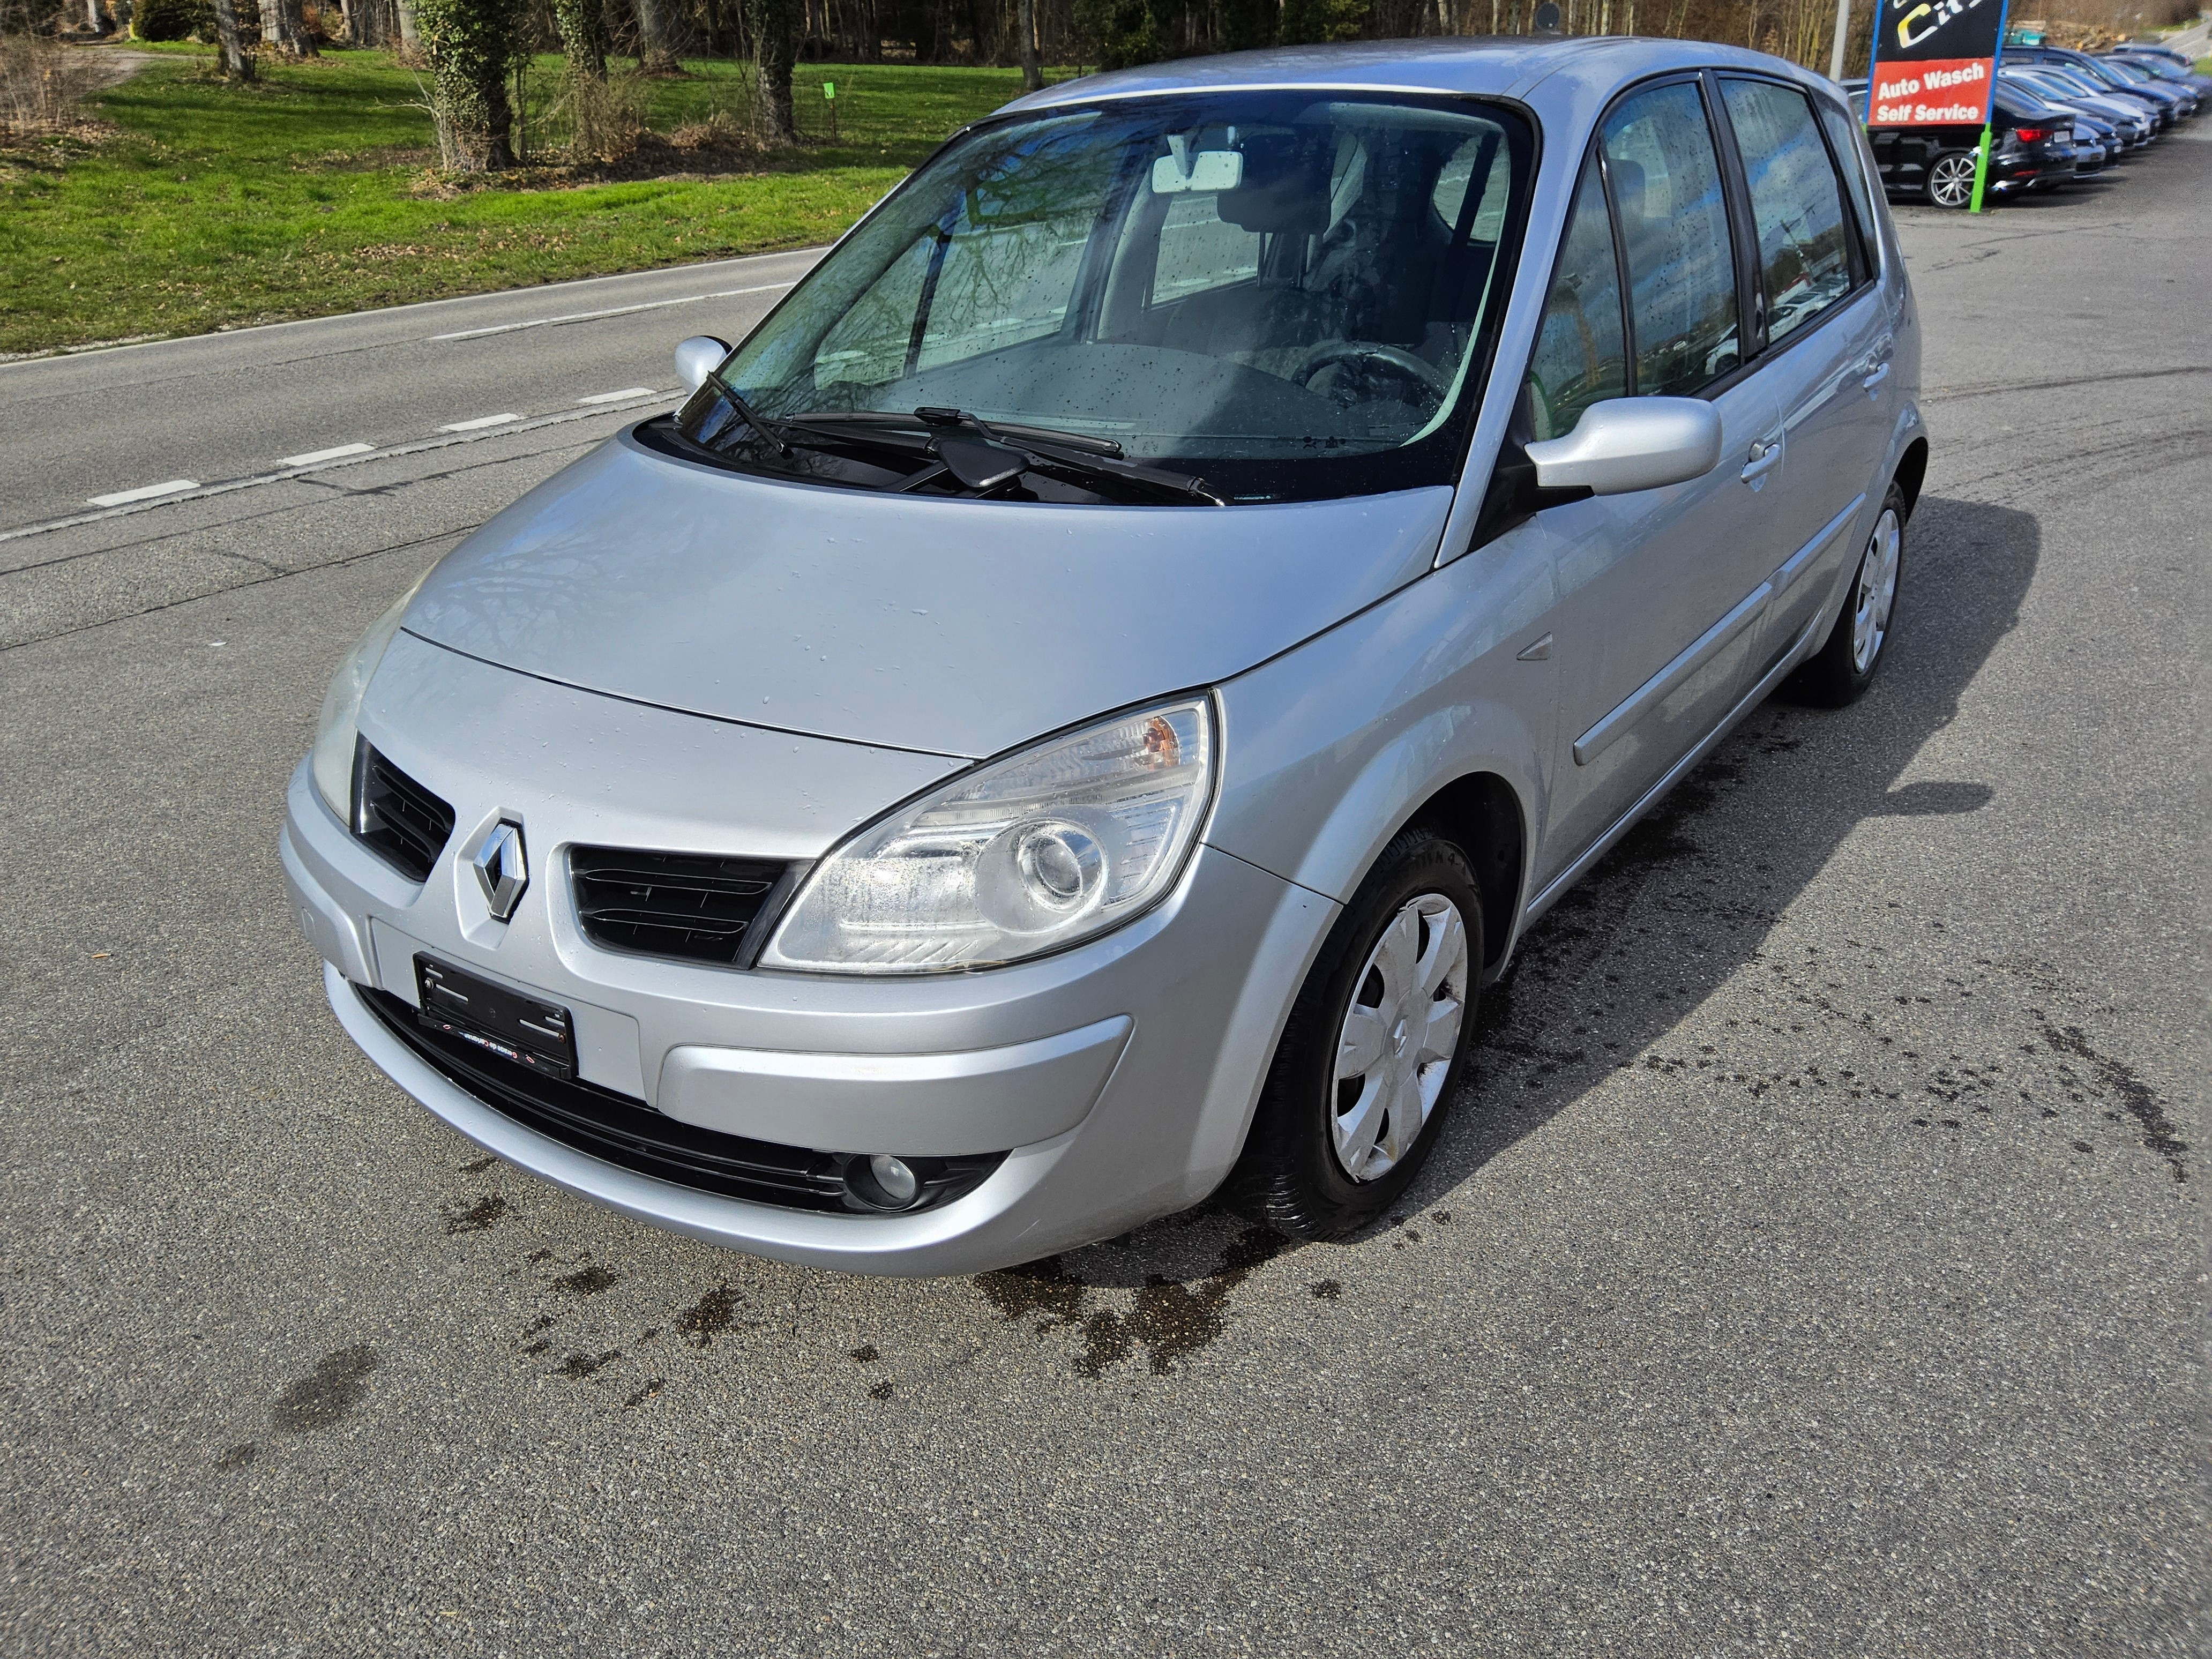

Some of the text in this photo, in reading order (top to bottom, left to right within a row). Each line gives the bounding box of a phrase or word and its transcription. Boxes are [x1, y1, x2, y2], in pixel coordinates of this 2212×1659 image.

[1878, 62, 1984, 100] Auto Wasch
[1877, 103, 1978, 122] Self Service
